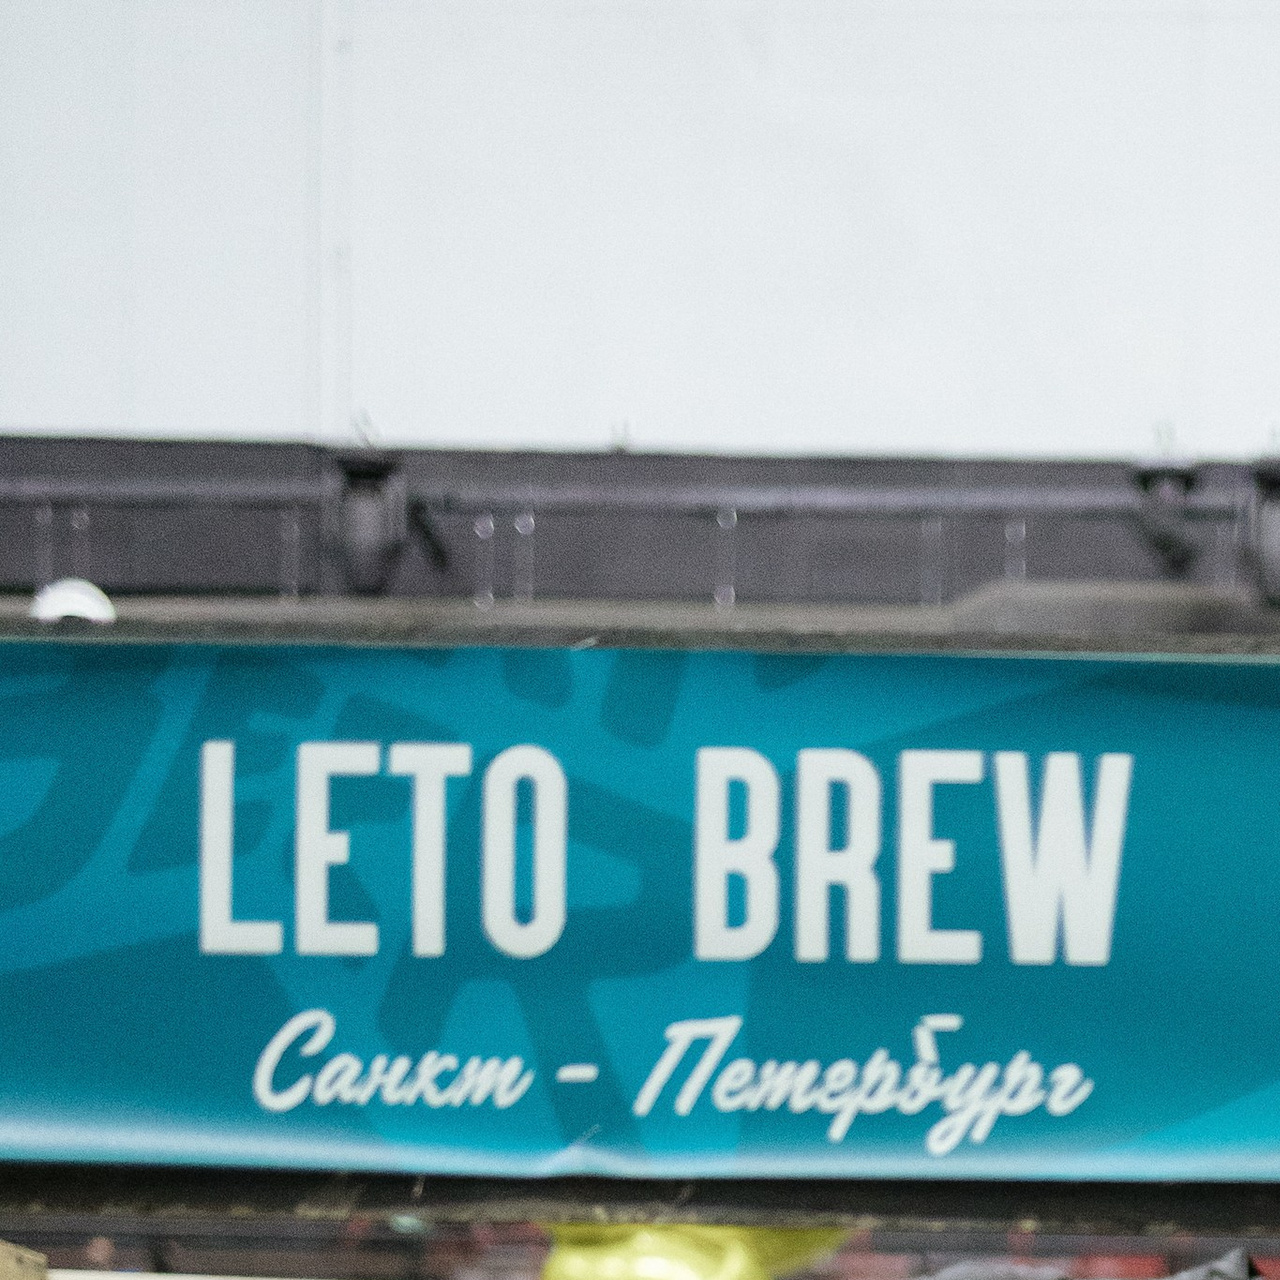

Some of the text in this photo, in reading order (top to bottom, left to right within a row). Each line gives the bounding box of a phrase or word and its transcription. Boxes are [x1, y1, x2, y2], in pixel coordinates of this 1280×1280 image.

[200, 739, 1134, 967] LETO BREW
[253, 1008, 533, 1113] Санкт
[633, 1013, 1094, 1156] Петербург
